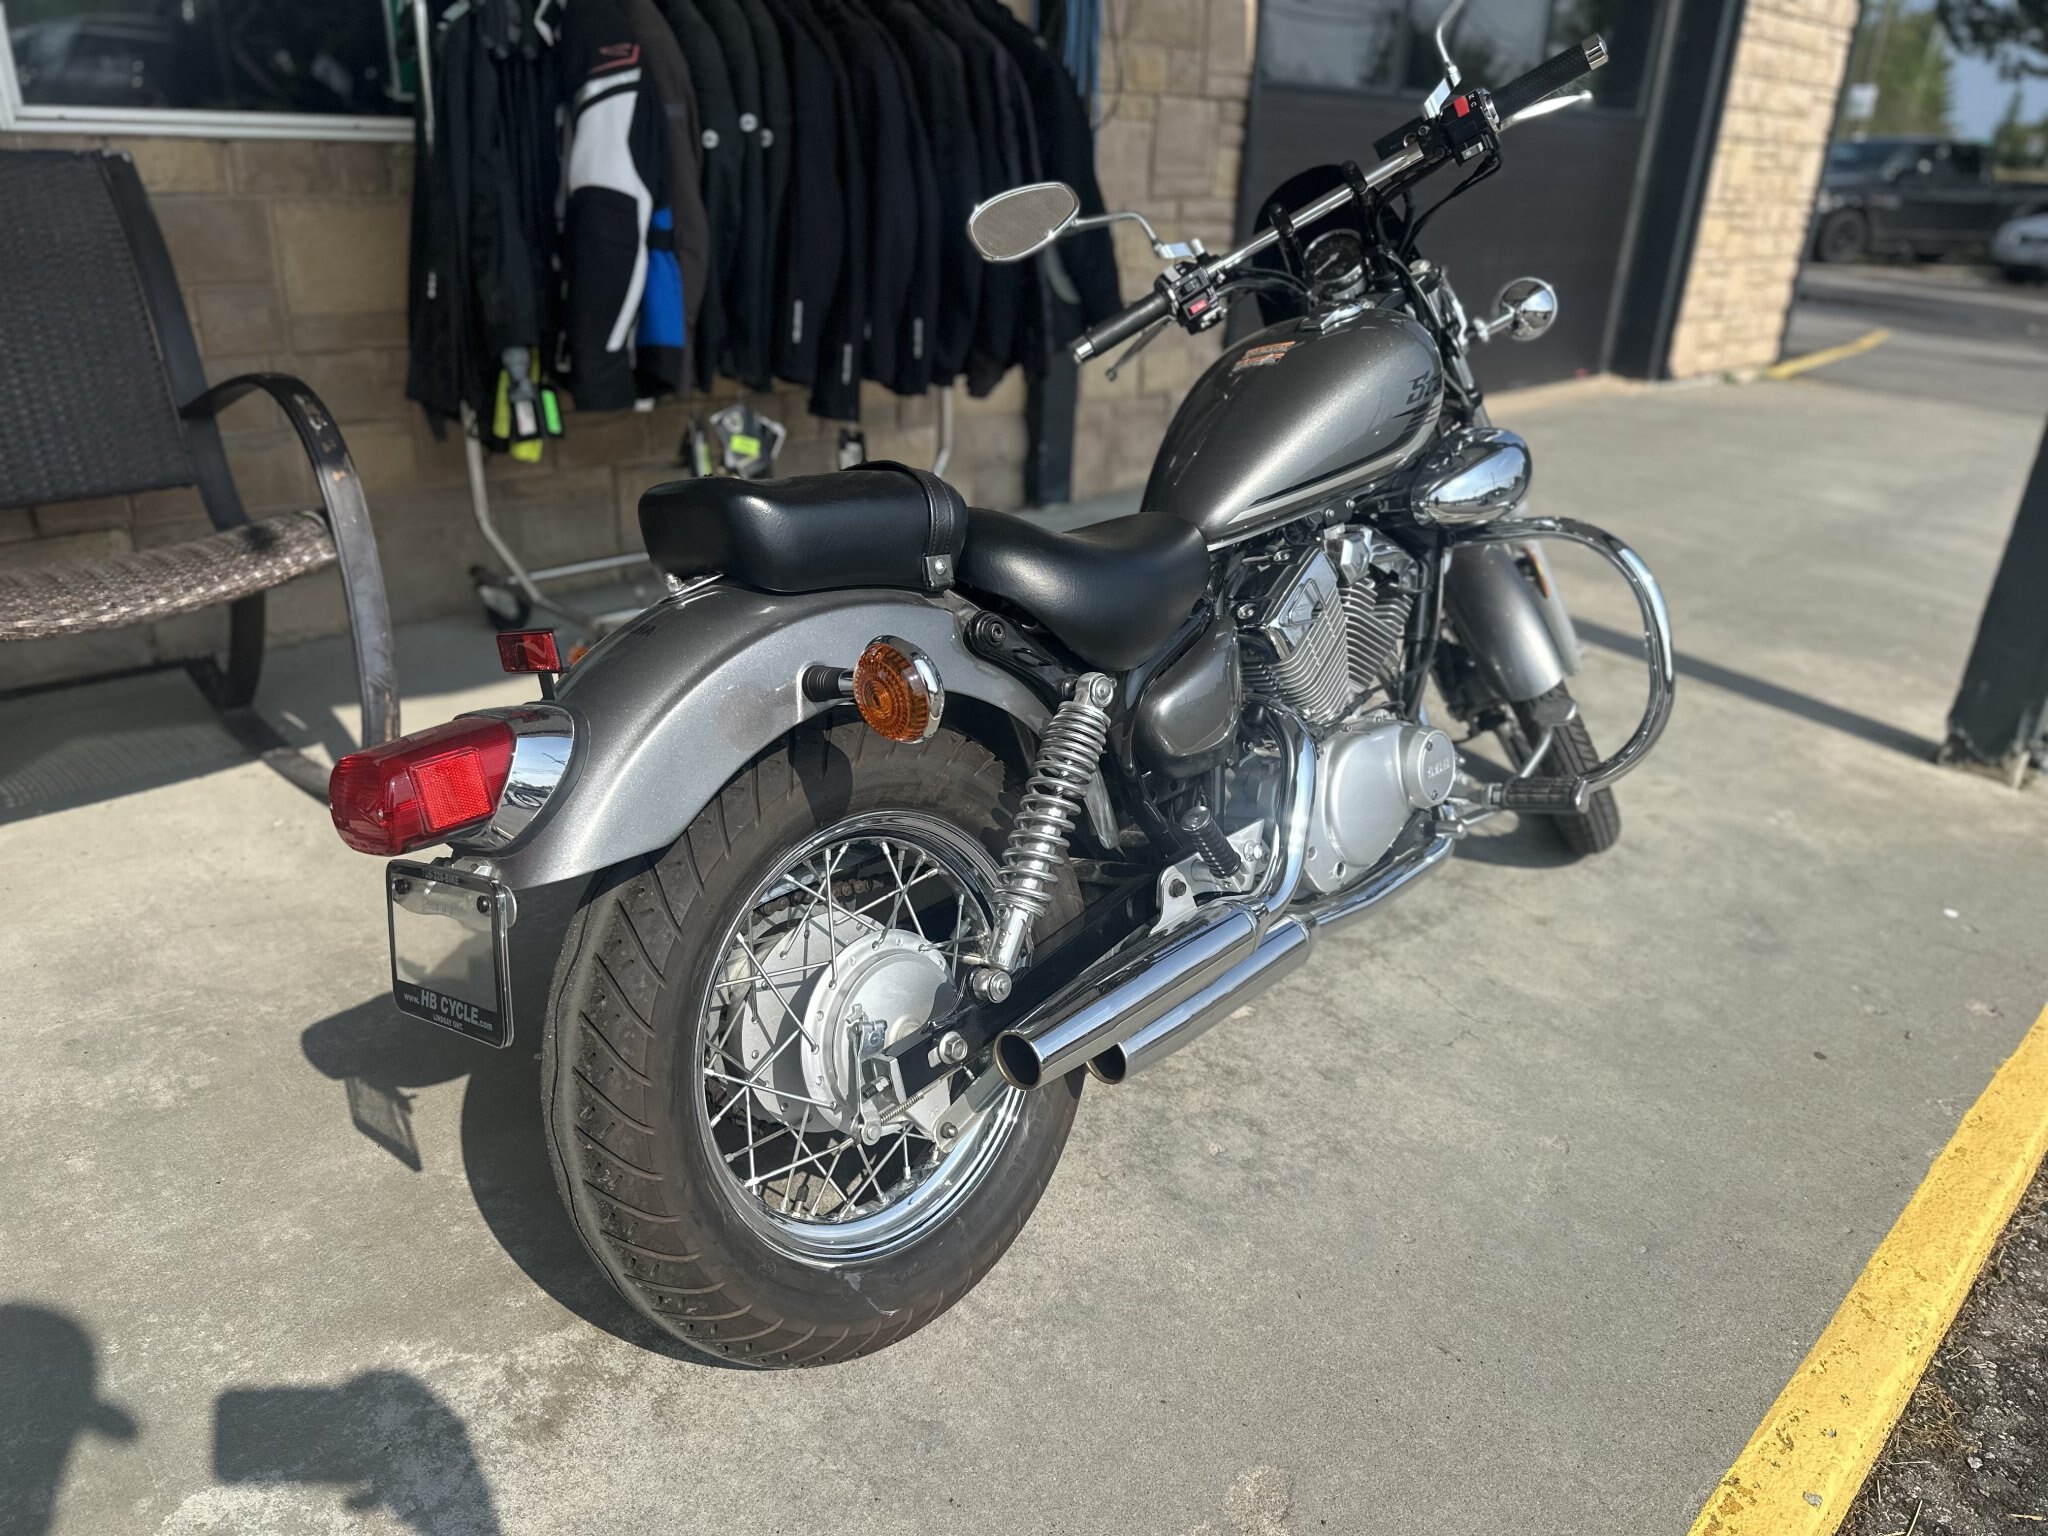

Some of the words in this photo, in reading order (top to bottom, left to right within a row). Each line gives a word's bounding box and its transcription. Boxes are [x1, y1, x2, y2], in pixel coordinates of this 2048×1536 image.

[403, 992, 420, 1004] www.
[421, 989, 438, 1010] HB
[433, 1013, 452, 1027] LINDSAY
